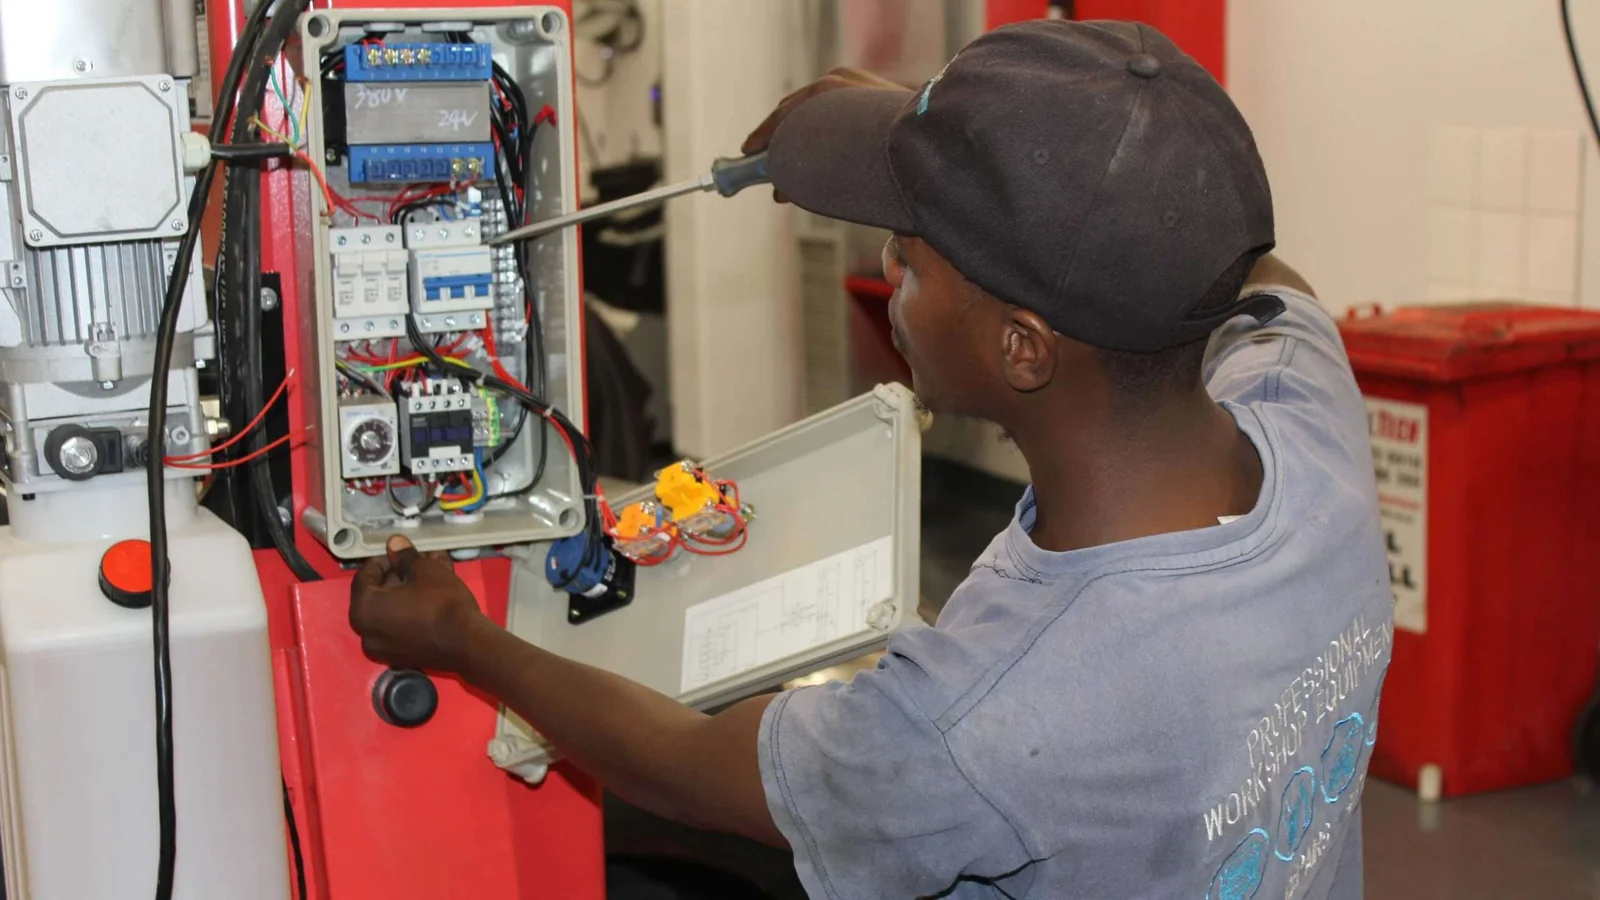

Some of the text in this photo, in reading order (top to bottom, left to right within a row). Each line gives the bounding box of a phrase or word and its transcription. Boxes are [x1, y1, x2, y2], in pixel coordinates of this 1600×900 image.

[354, 83, 408, 110] 380V
[1204, 614, 1391, 841] WORKSHOP EQUIPMEN
[1247, 613, 1370, 768] PROFESSIONAL
